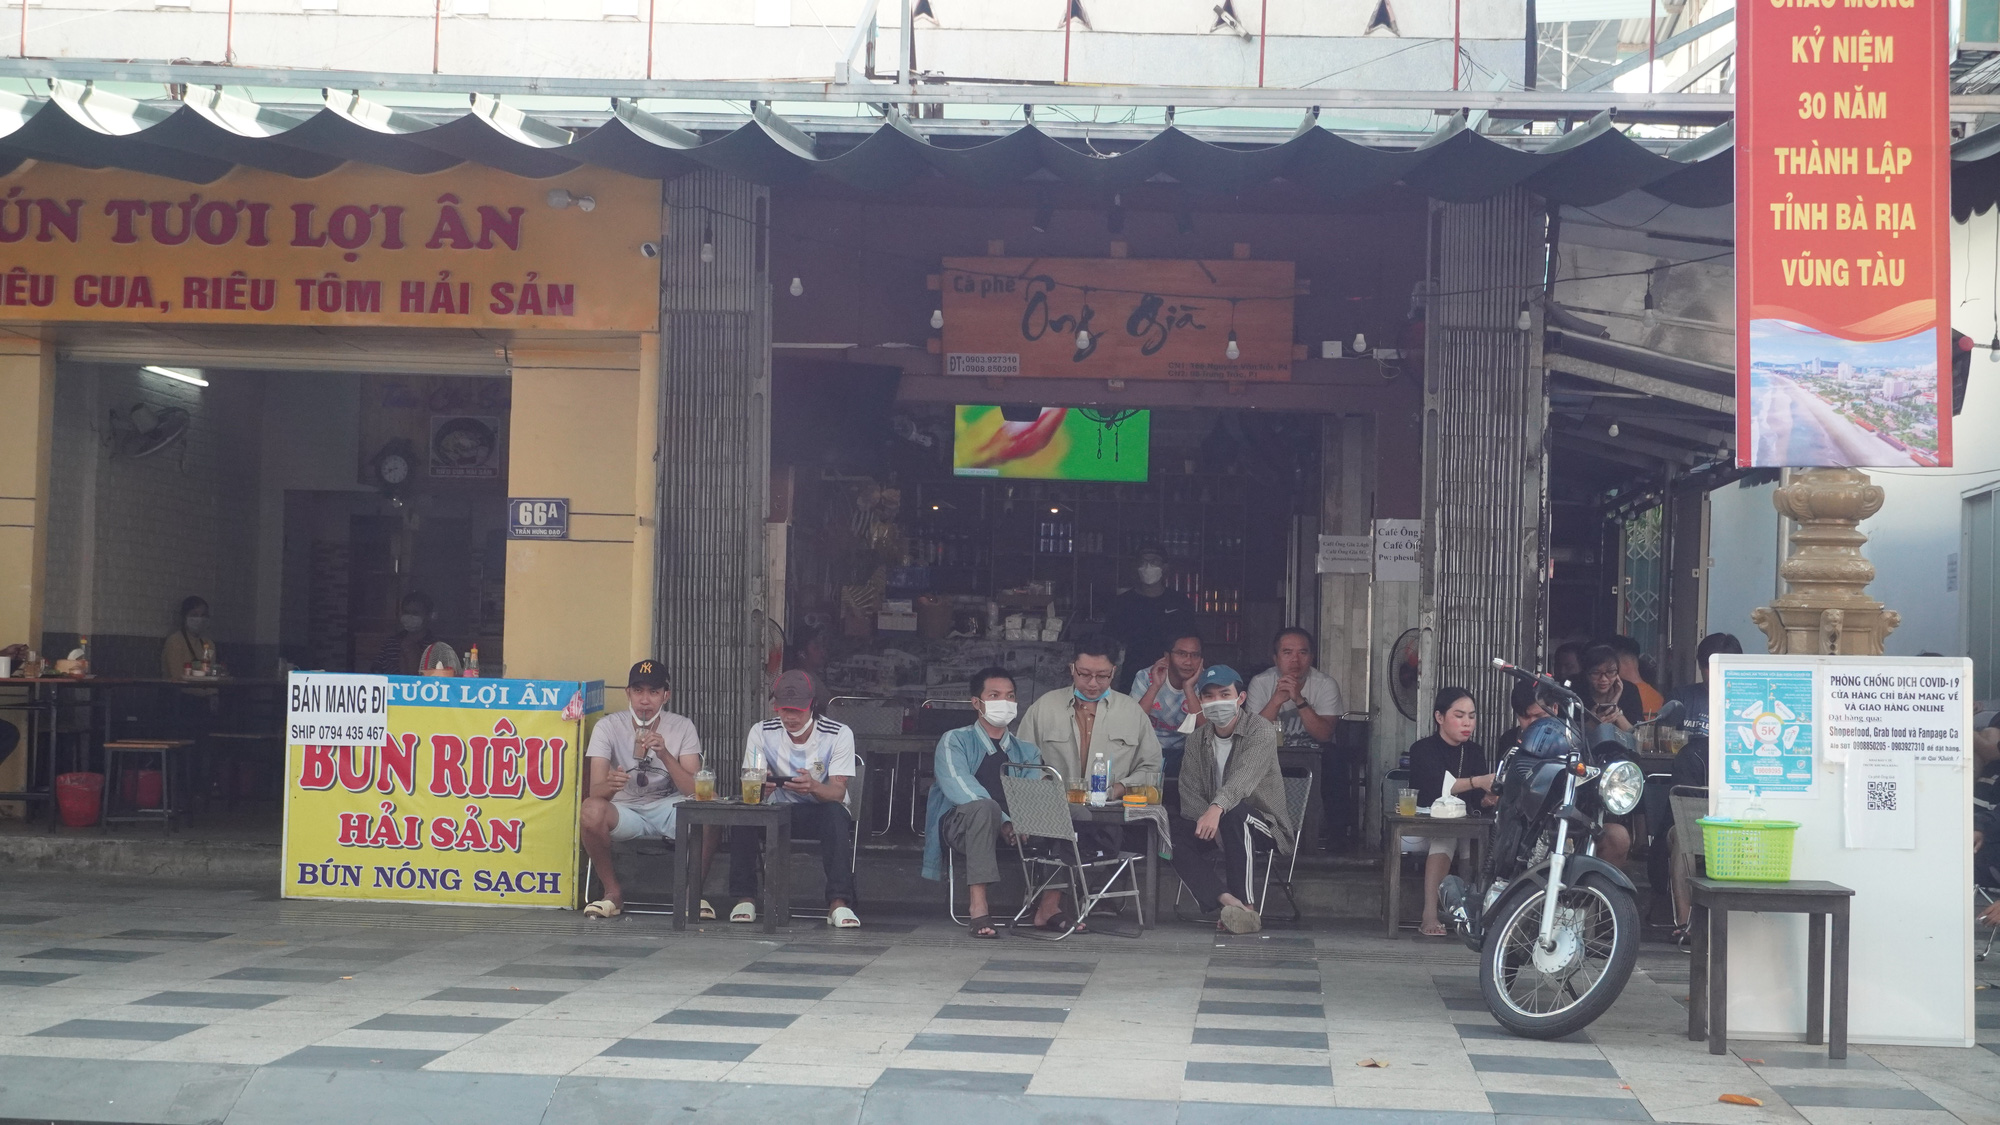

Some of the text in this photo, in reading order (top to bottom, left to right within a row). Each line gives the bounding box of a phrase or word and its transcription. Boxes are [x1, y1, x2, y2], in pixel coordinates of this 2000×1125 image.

[1792, 25, 1894, 72] KỶ NIỆM
[1798, 85, 1887, 119] 30 NĂM
[1774, 139, 1913, 183] THÀNH LẬP
[104, 193, 271, 247] TƯƠI
[290, 203, 405, 263] LỢI
[425, 192, 525, 251] ÂN
[1770, 192, 1916, 239] TỈNH BÀ RỊA
[1781, 250, 1905, 287] VŨNG TÀU
[73, 274, 170, 313] CUA,
[183, 270, 276, 311] RIÊU
[295, 272, 382, 313] TÔM
[400, 270, 470, 315] HẢI
[490, 271, 574, 316] SẢN
[965, 365, 1017, 373] 0908.850205
[519, 502, 558, 526] 66A
[1378, 526, 1419, 538] Café Ông
[1383, 541, 1403, 550] Café
[1394, 554, 1414, 562] phesu
[1830, 673, 1960, 689] PHÒNG CHỐNG DỊCH COVID-19
[292, 677, 386, 714] BÁN MANG ĐI
[387, 681, 450, 702] TƯƠI
[460, 683, 509, 708] LỢI
[518, 682, 561, 706] ÂN
[1844, 702, 1945, 712] VÀ GIAO HÀNG ONLINE
[1851, 690, 1877, 699] HÀNG
[1918, 693, 1945, 701] MANG
[291, 725, 385, 741] SHIP 0794 435 467
[1761, 726, 1776, 736] 5K
[1873, 726, 1890, 738] Grab
[1891, 727, 1906, 738] food
[1908, 727, 1916, 738] và
[1918, 727, 1947, 739] Fanpage
[1949, 728, 1959, 739] Ca
[429, 717, 568, 800] RIÊU
[1891, 741, 1925, 751] 0903927310
[337, 801, 524, 852] HẢI SẢN
[297, 858, 561, 897] BÚN NÓNG SẠCH
